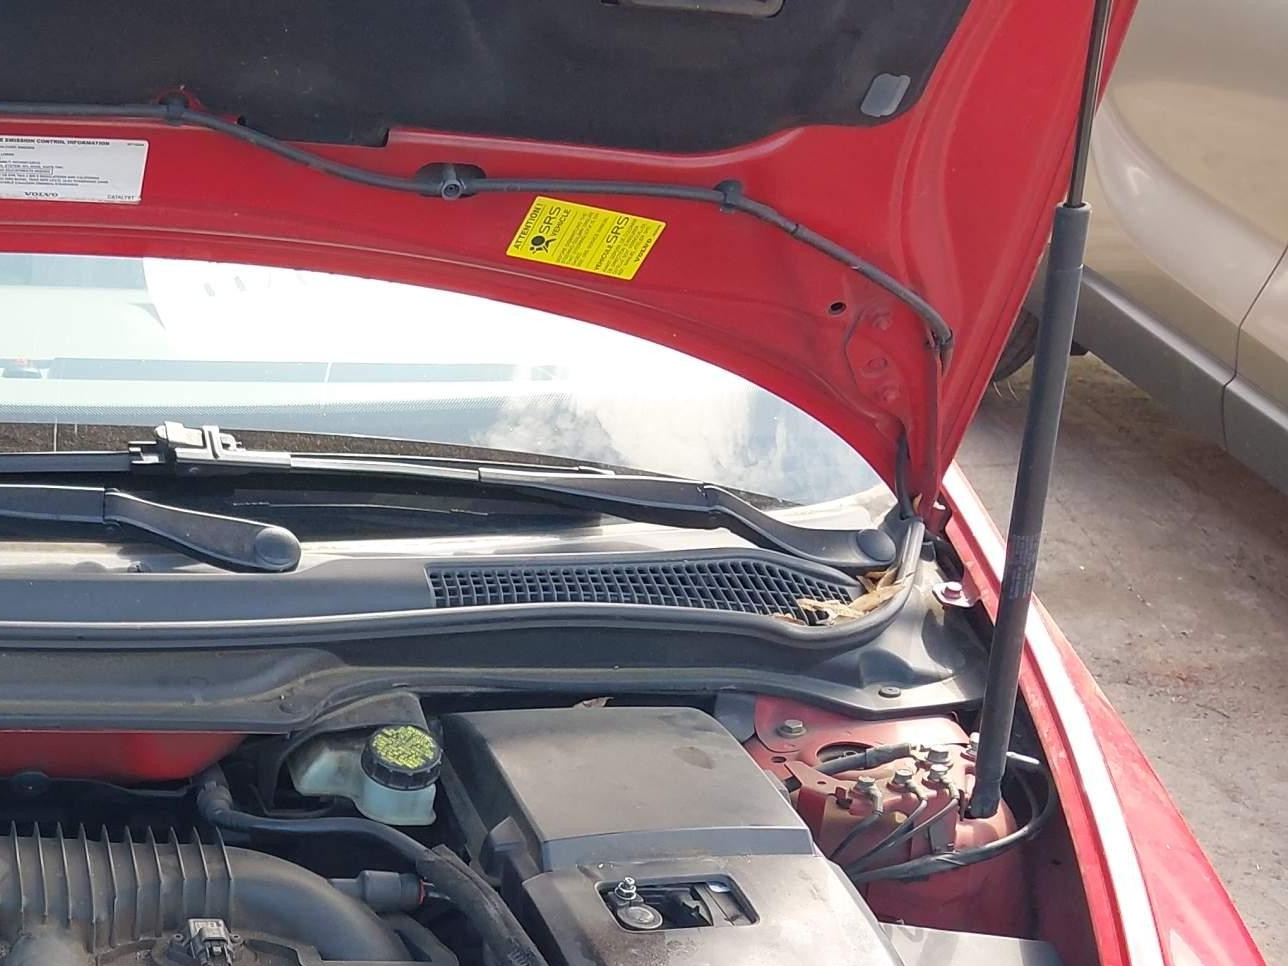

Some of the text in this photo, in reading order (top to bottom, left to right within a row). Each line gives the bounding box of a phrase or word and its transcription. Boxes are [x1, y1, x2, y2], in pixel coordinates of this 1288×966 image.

[538, 205, 561, 234] SRS
[551, 208, 571, 237] VEHICLE
[605, 214, 630, 244] SRS
[633, 237, 653, 262] VOLVO
